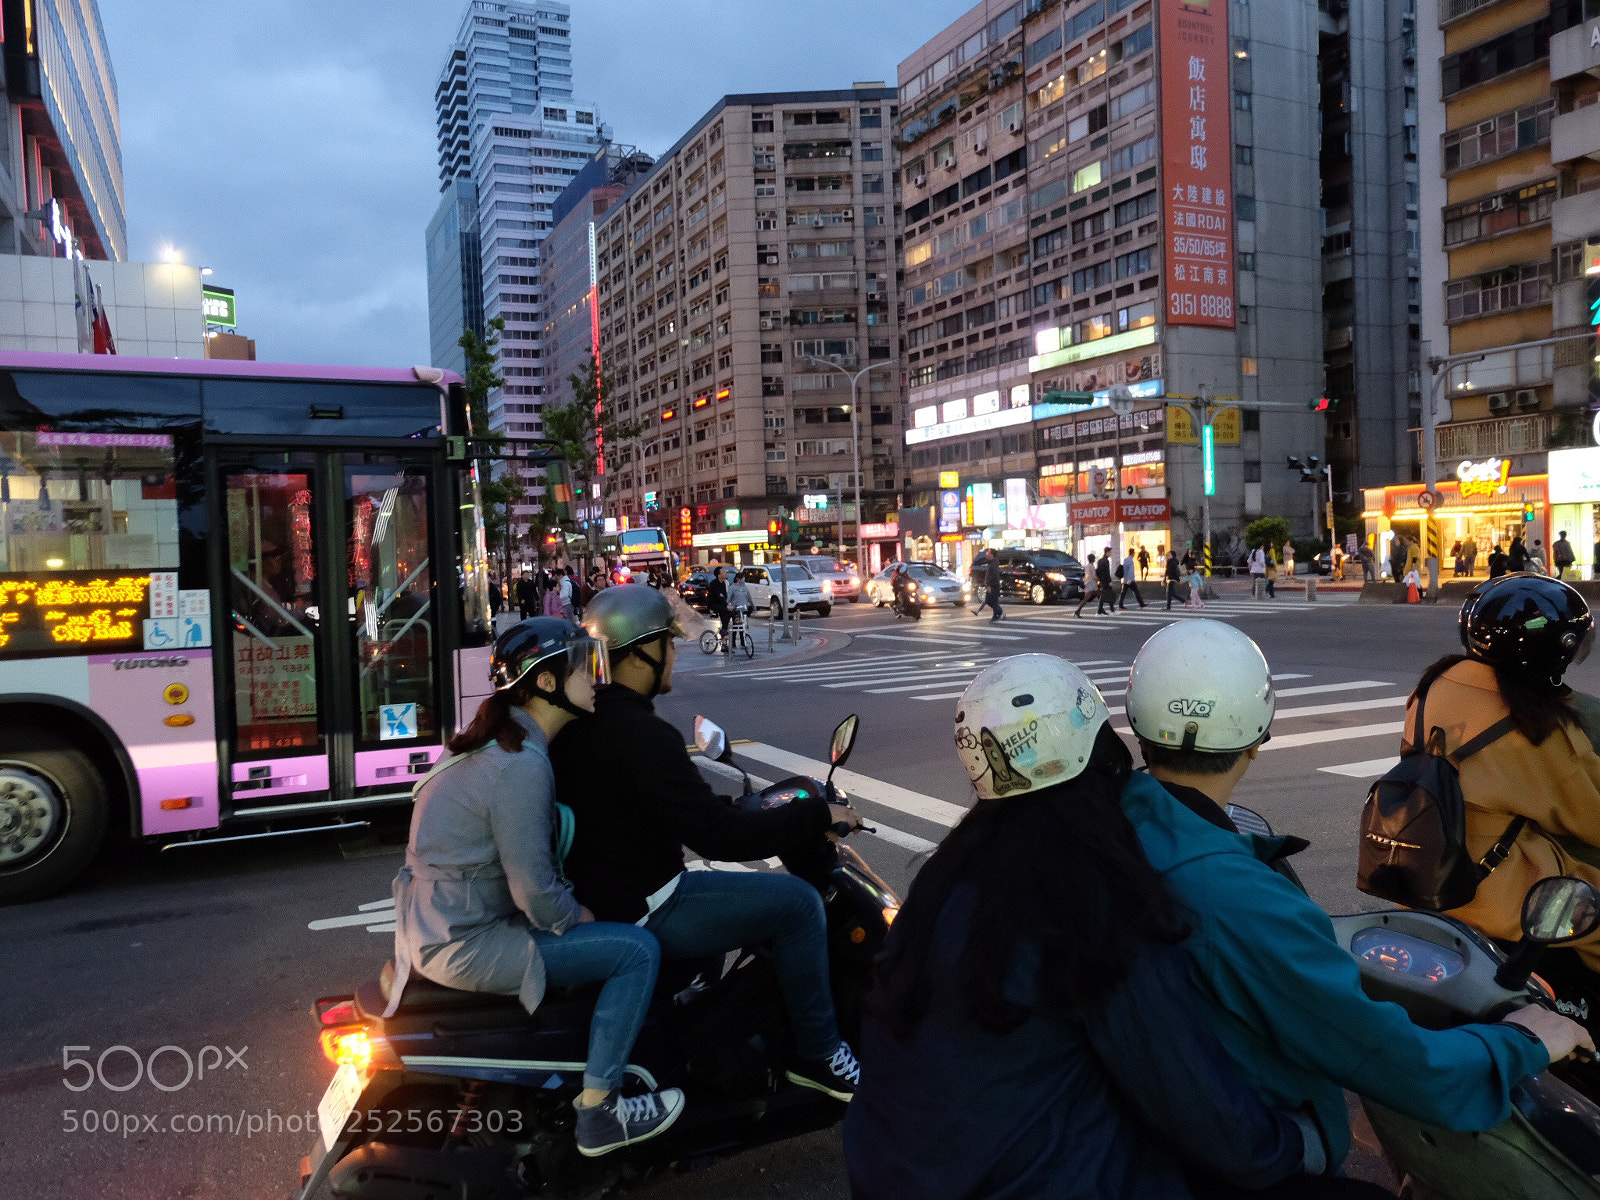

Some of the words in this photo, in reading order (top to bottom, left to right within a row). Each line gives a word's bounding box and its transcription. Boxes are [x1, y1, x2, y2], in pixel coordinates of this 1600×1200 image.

[1187, 55, 1208, 171] 飯店寓邸
[1172, 183, 1226, 206] 大陸建設
[1174, 263, 1228, 285] 松江南京
[1171, 292, 1197, 315] 3151
[1200, 294, 1232, 319] 8888
[111, 656, 189, 671] YUTONG
[1000, 720, 1038, 750] HELLO
[1005, 732, 1038, 761] KITTY
